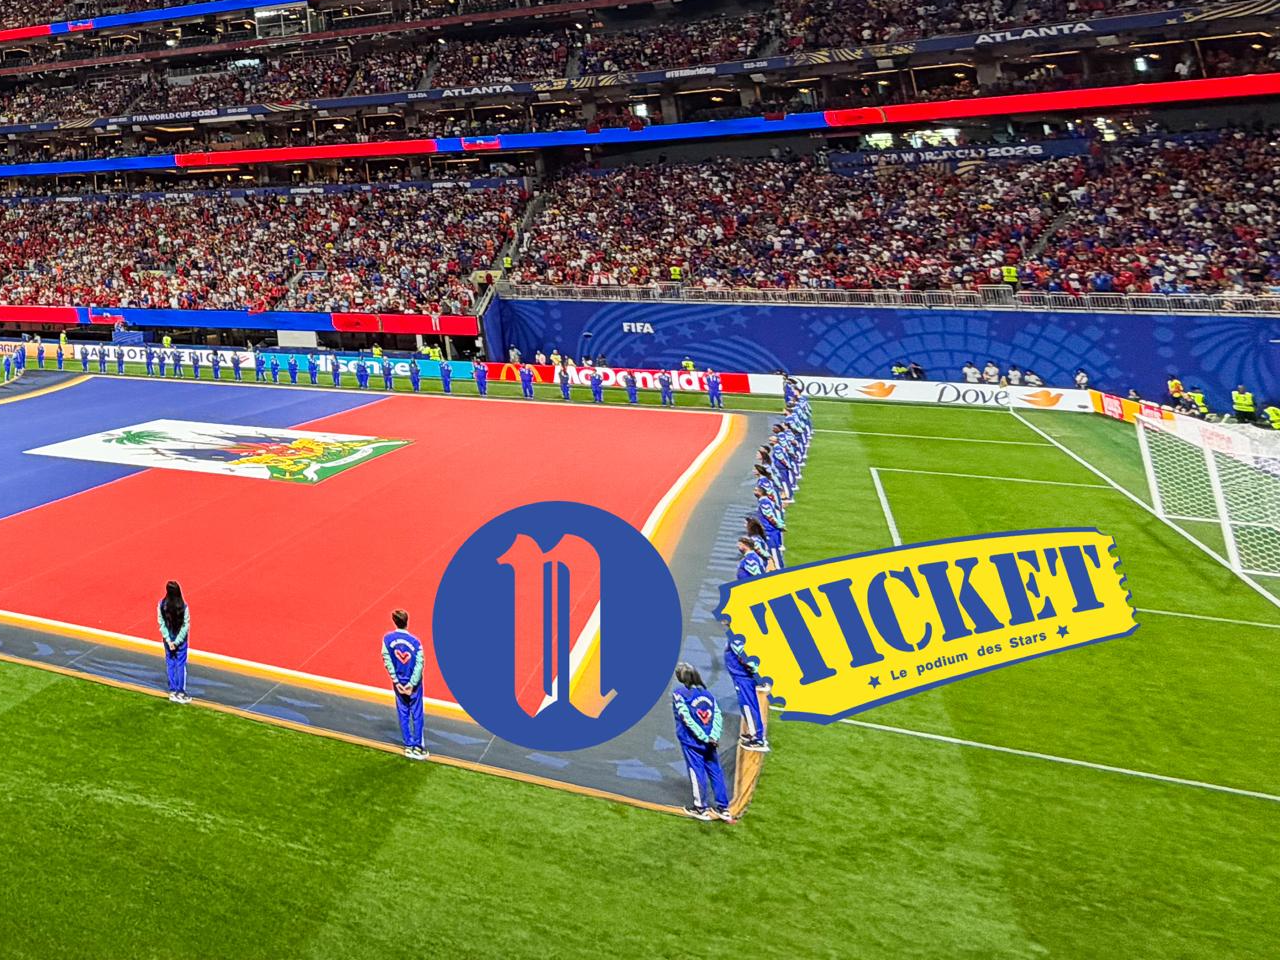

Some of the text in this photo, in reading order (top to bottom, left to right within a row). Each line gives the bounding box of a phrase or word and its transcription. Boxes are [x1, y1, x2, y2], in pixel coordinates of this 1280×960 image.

[975, 23, 1094, 44] ATLANTA
[442, 85, 514, 97] ATLANTA
[191, 109, 217, 117] 2026
[623, 322, 654, 334] FIFA
[317, 355, 410, 376] Hisene
[936, 382, 1010, 405] Dove
